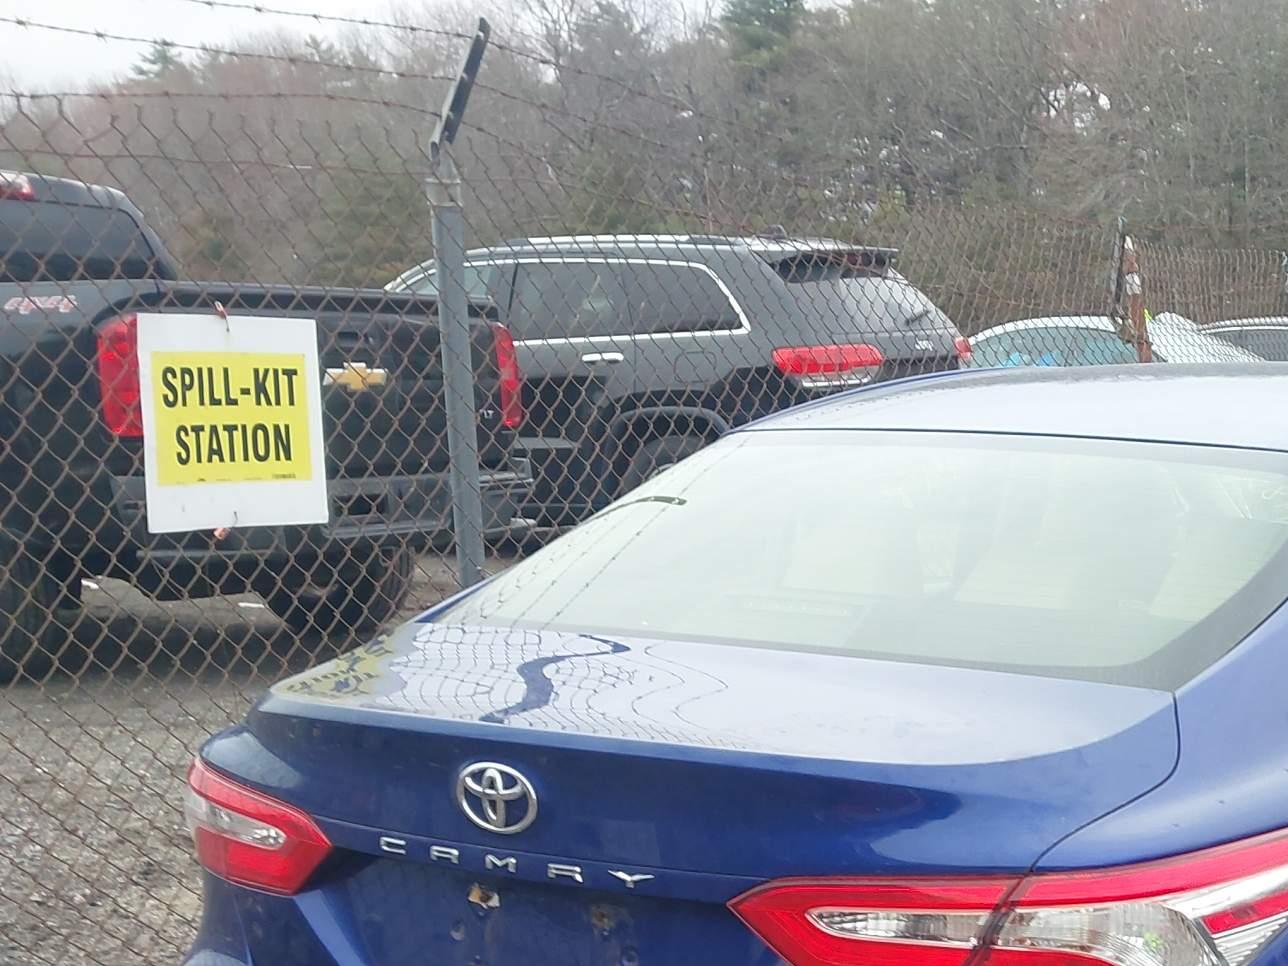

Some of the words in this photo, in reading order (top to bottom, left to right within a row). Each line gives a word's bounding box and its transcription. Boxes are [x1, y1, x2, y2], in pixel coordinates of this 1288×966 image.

[162, 366, 298, 408] SPILL-KIT
[176, 423, 292, 465] STATION
[380, 836, 655, 888] CAMRY
